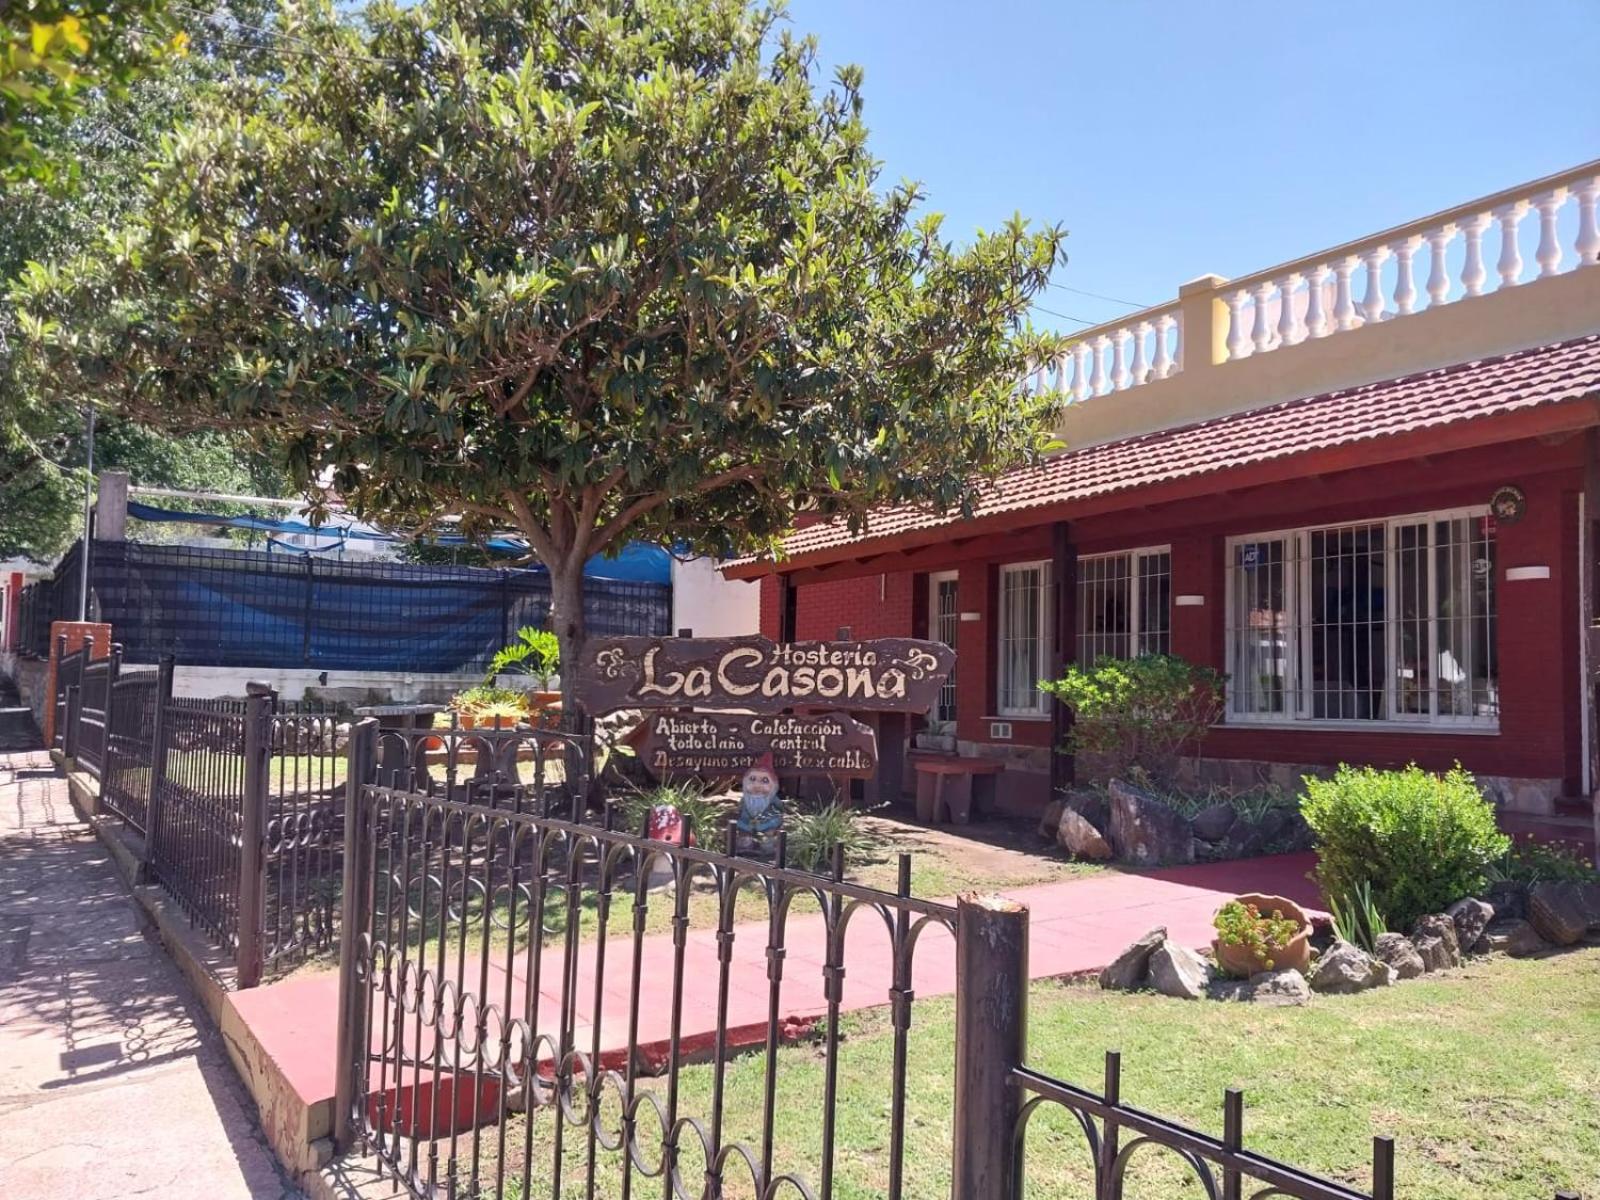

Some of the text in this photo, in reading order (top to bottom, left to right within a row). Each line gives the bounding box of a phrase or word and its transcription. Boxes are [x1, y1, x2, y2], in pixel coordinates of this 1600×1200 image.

[638, 646, 906, 699] La Casona
[655, 716, 718, 736] Abierto
[750, 718, 843, 735] Calefacción
[667, 734, 827, 752] todo el año central
[654, 750, 729, 771] Desayuno
[828, 749, 872, 769] cable
